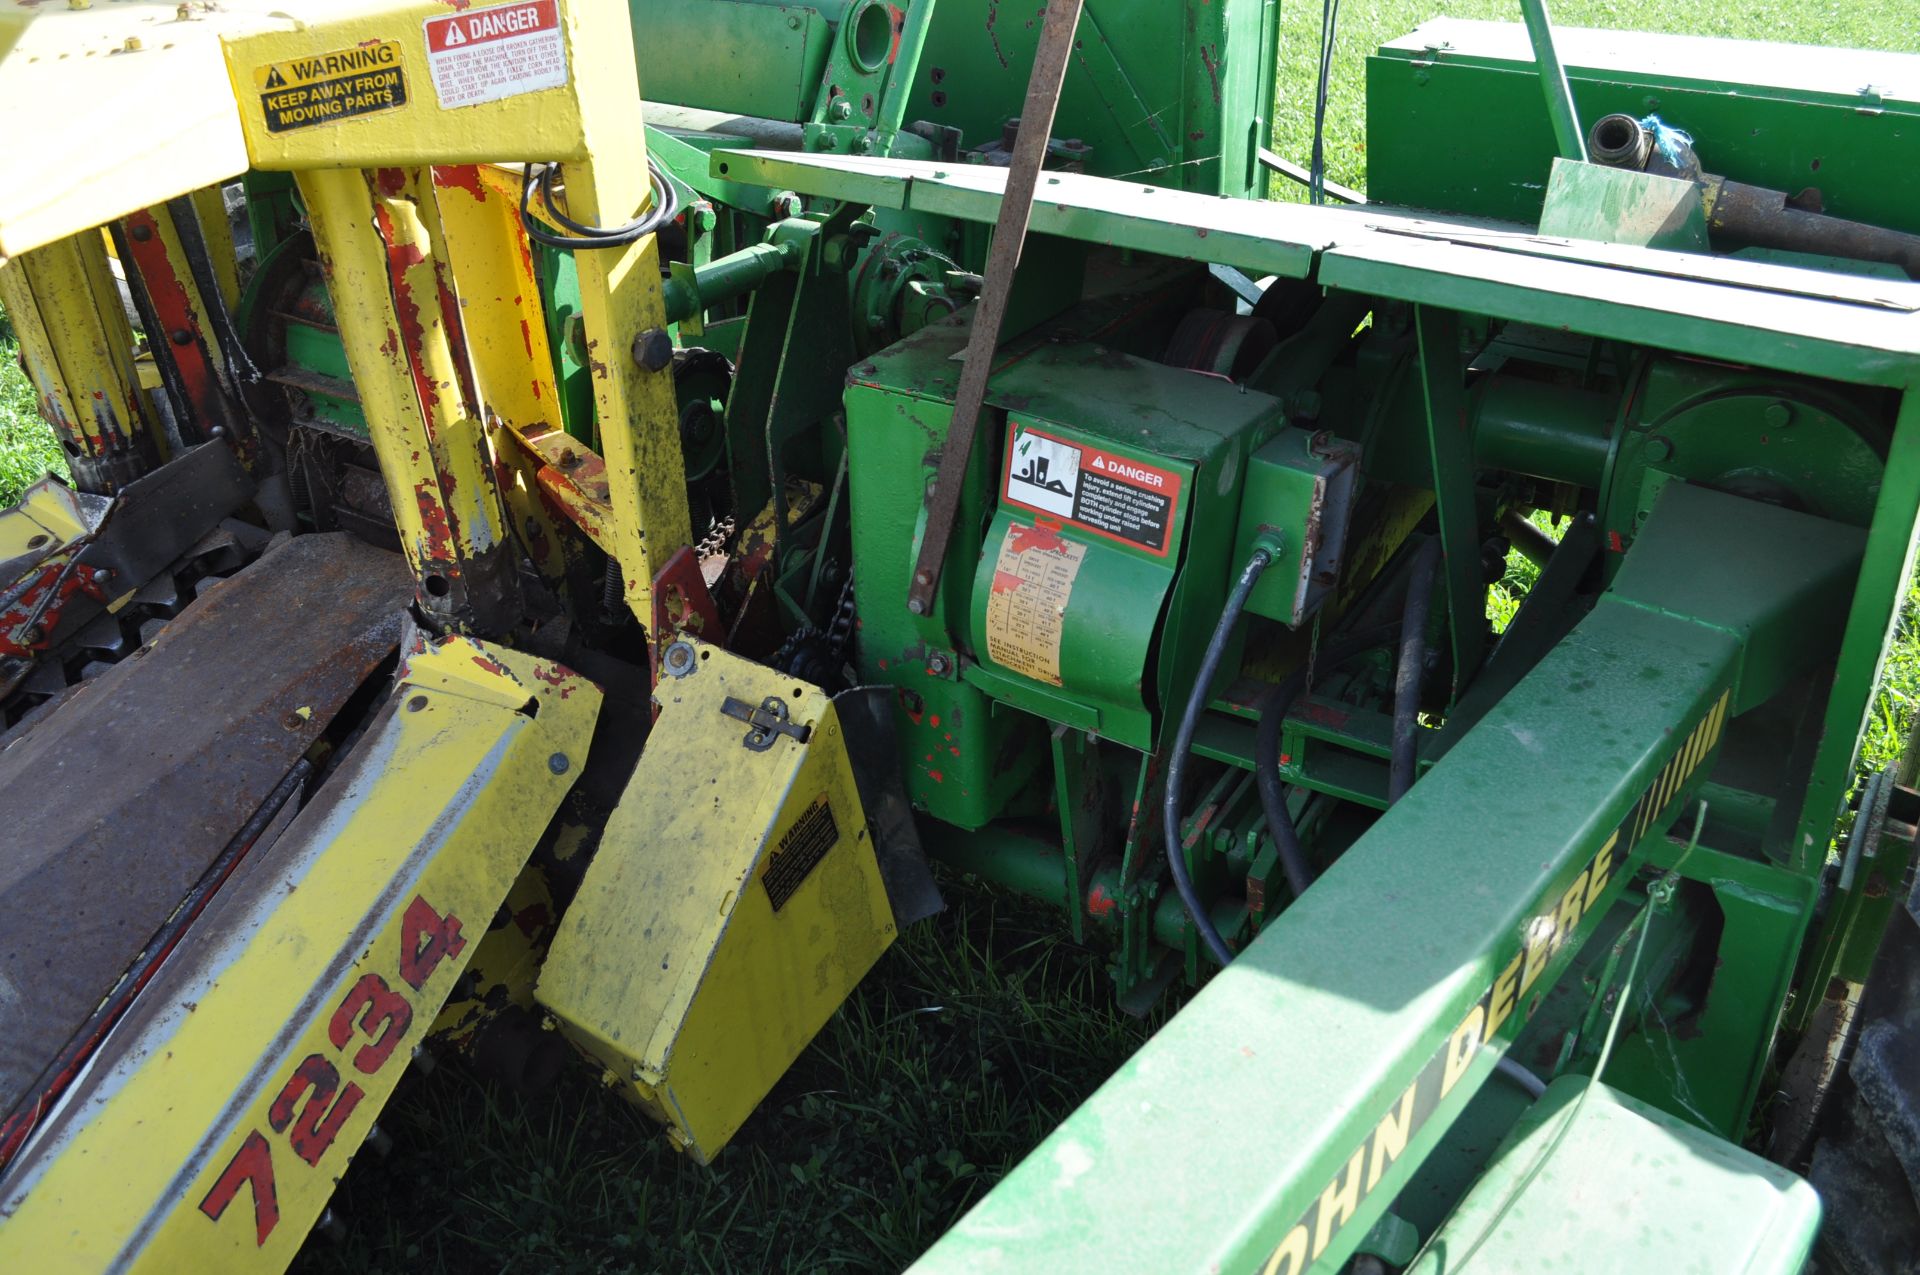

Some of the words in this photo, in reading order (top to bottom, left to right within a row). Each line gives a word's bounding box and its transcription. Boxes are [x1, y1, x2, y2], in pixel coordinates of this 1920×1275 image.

[470, 7, 540, 40] DANGER
[292, 46, 394, 80] WARNING
[435, 55, 453, 65] WHEN
[477, 47, 494, 56] LOOSE
[506, 40, 527, 50] BROKEN
[528, 34, 557, 45] GATHERING
[456, 60, 470, 68] STOP
[511, 48, 525, 57] TURN
[527, 46, 536, 54] OFF
[452, 69, 464, 77] AND
[466, 64, 487, 74] REMOVE
[490, 61, 500, 69] THE
[528, 53, 537, 61] KEY
[457, 75, 475, 84] WHEN
[477, 71, 495, 80] CHAIN
[527, 60, 542, 69] CORN
[545, 56, 560, 65] HEAD
[268, 90, 308, 111] KEEP
[311, 80, 353, 104] AWAY
[356, 72, 398, 92] FROM
[441, 86, 459, 96] COULD
[461, 82, 478, 91] START
[490, 76, 506, 85] AGAIN
[456, 92, 465, 100] OR
[279, 100, 342, 125] MOVING
[345, 89, 393, 110] PARTS
[1108, 461, 1164, 487] DANGER
[1081, 488, 1113, 505] completely
[1114, 500, 1125, 508] and
[1126, 505, 1148, 518] engage
[1084, 473, 1092, 481] To
[1092, 476, 1109, 487] avoid
[1115, 483, 1137, 496] serious
[1137, 490, 1164, 506] crushing
[1102, 487, 1122, 499] extend
[1123, 494, 1131, 502] lift
[1132, 497, 1159, 513] cylinders
[1077, 512, 1109, 529] harvesting
[1109, 522, 1121, 532] unit
[1079, 504, 1102, 518] working
[1103, 512, 1120, 523] under
[1121, 518, 1140, 530] raised
[1080, 496, 1098, 508] BOTH
[1098, 502, 1122, 517] cylinder
[1123, 511, 1139, 522] stops
[1140, 517, 1160, 529] before
[989, 635, 1001, 644] SEE
[1003, 641, 1050, 664] INSTRUCTION
[990, 642, 1019, 657] MANUAL
[1021, 654, 1035, 663] FOR
[991, 648, 1035, 670] ATTACHMENT
[991, 653, 1029, 672] SPROCKETS
[779, 801, 820, 850] WARNING
[1263, 1081, 1416, 1275] OHN
[1441, 828, 1620, 1100] DEERE
[198, 893, 468, 1248] 7234
